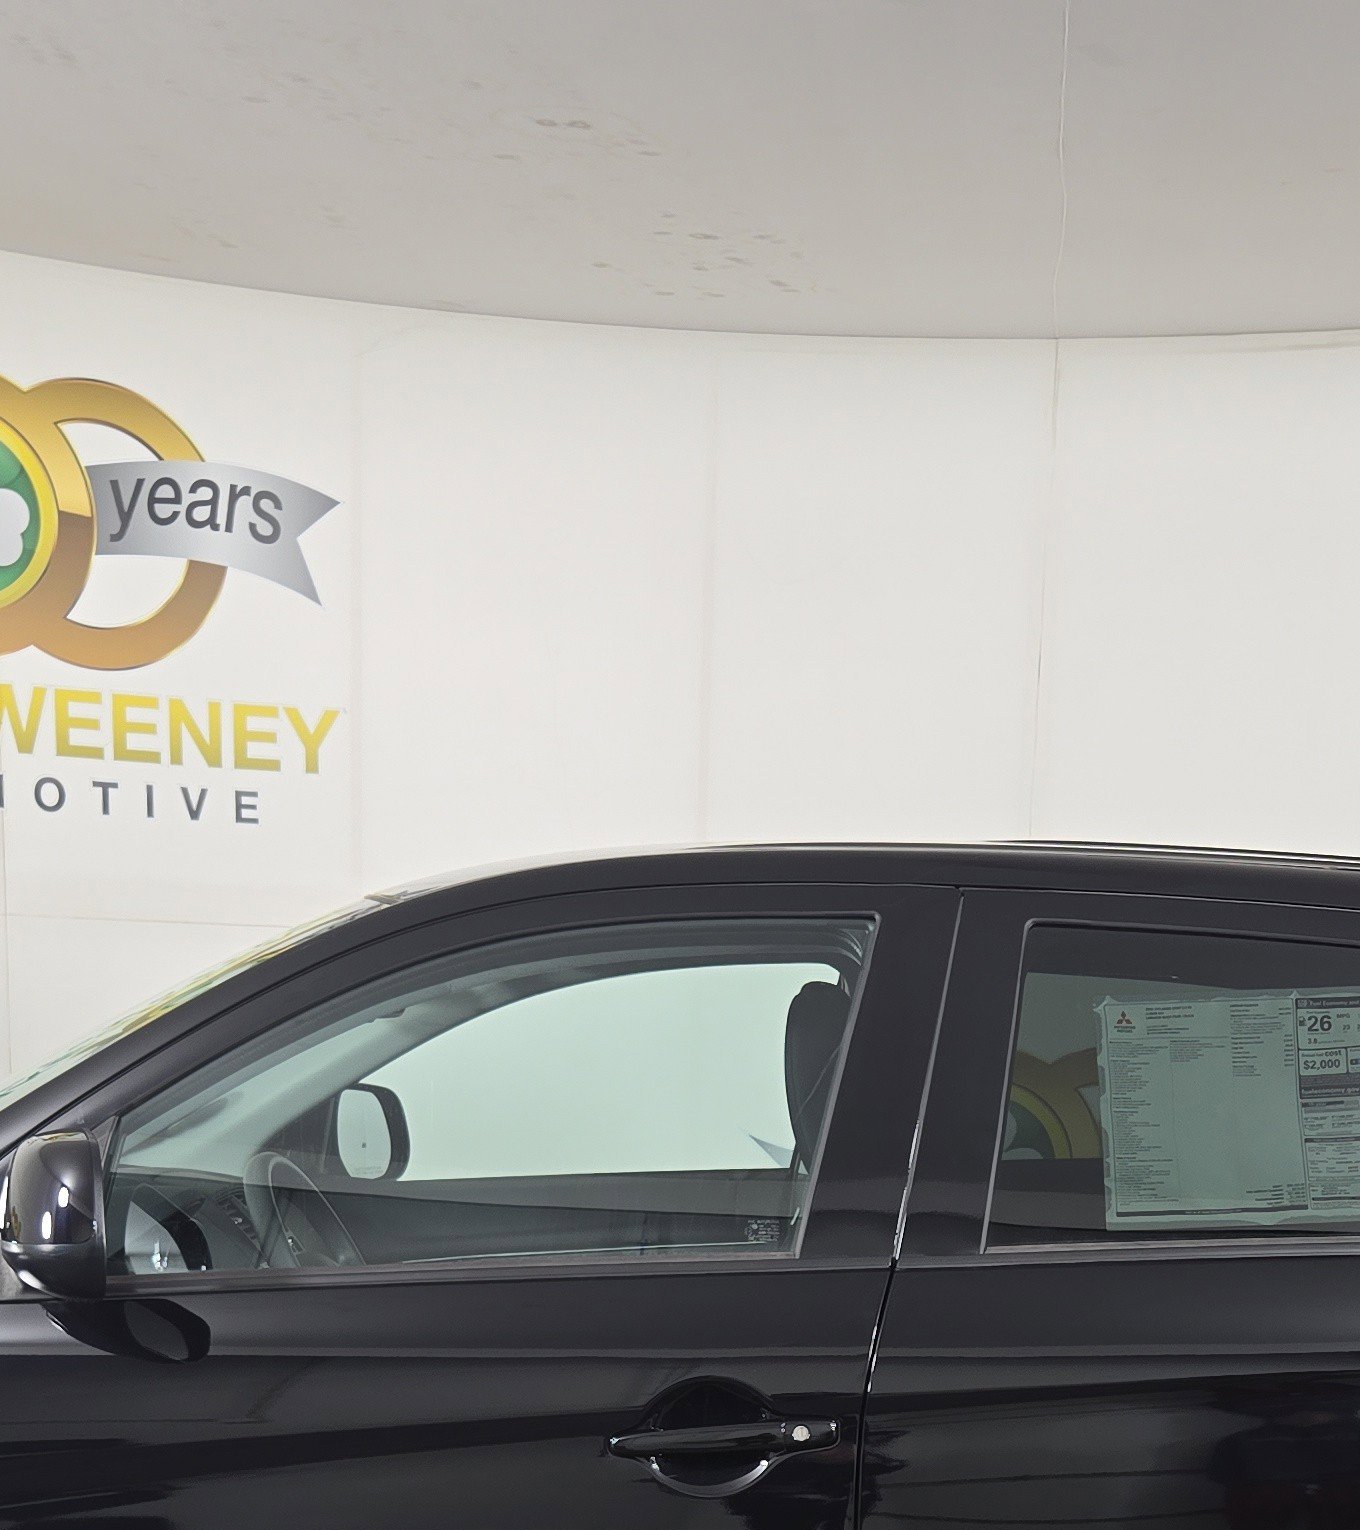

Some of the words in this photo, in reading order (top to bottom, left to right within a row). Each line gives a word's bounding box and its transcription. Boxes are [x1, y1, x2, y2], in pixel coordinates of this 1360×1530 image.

[107, 471, 284, 546] years
[1307, 1014, 1332, 1033] 26
[1303, 1059, 1341, 1071] $2,000
